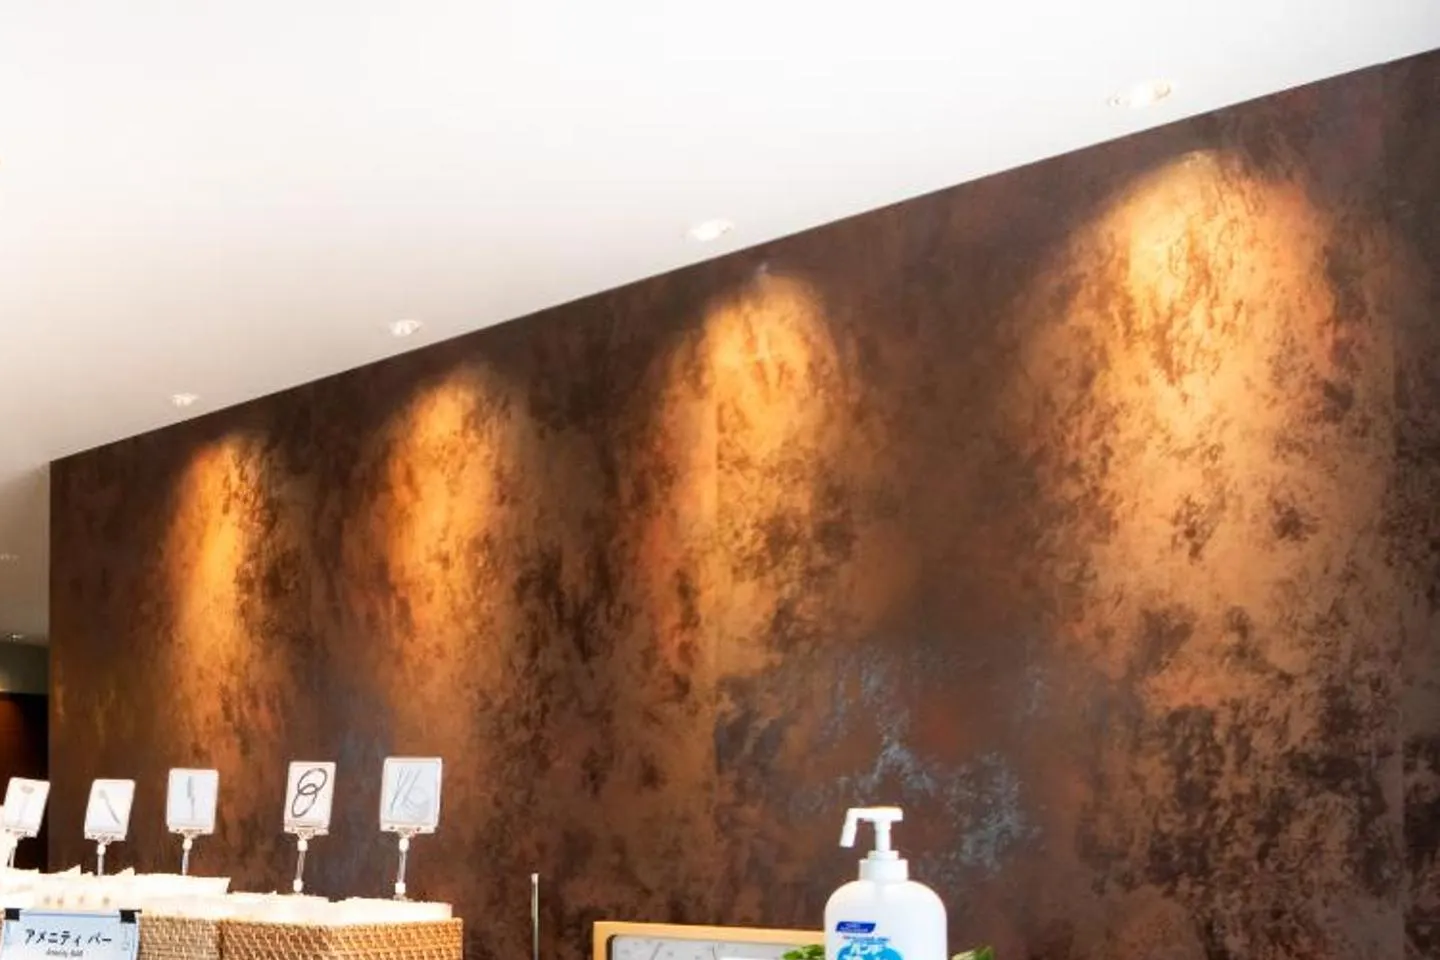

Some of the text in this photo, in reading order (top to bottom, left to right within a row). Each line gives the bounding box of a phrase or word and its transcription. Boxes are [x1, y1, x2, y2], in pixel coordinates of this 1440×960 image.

[25, 928, 112, 946] アメニティ バー
